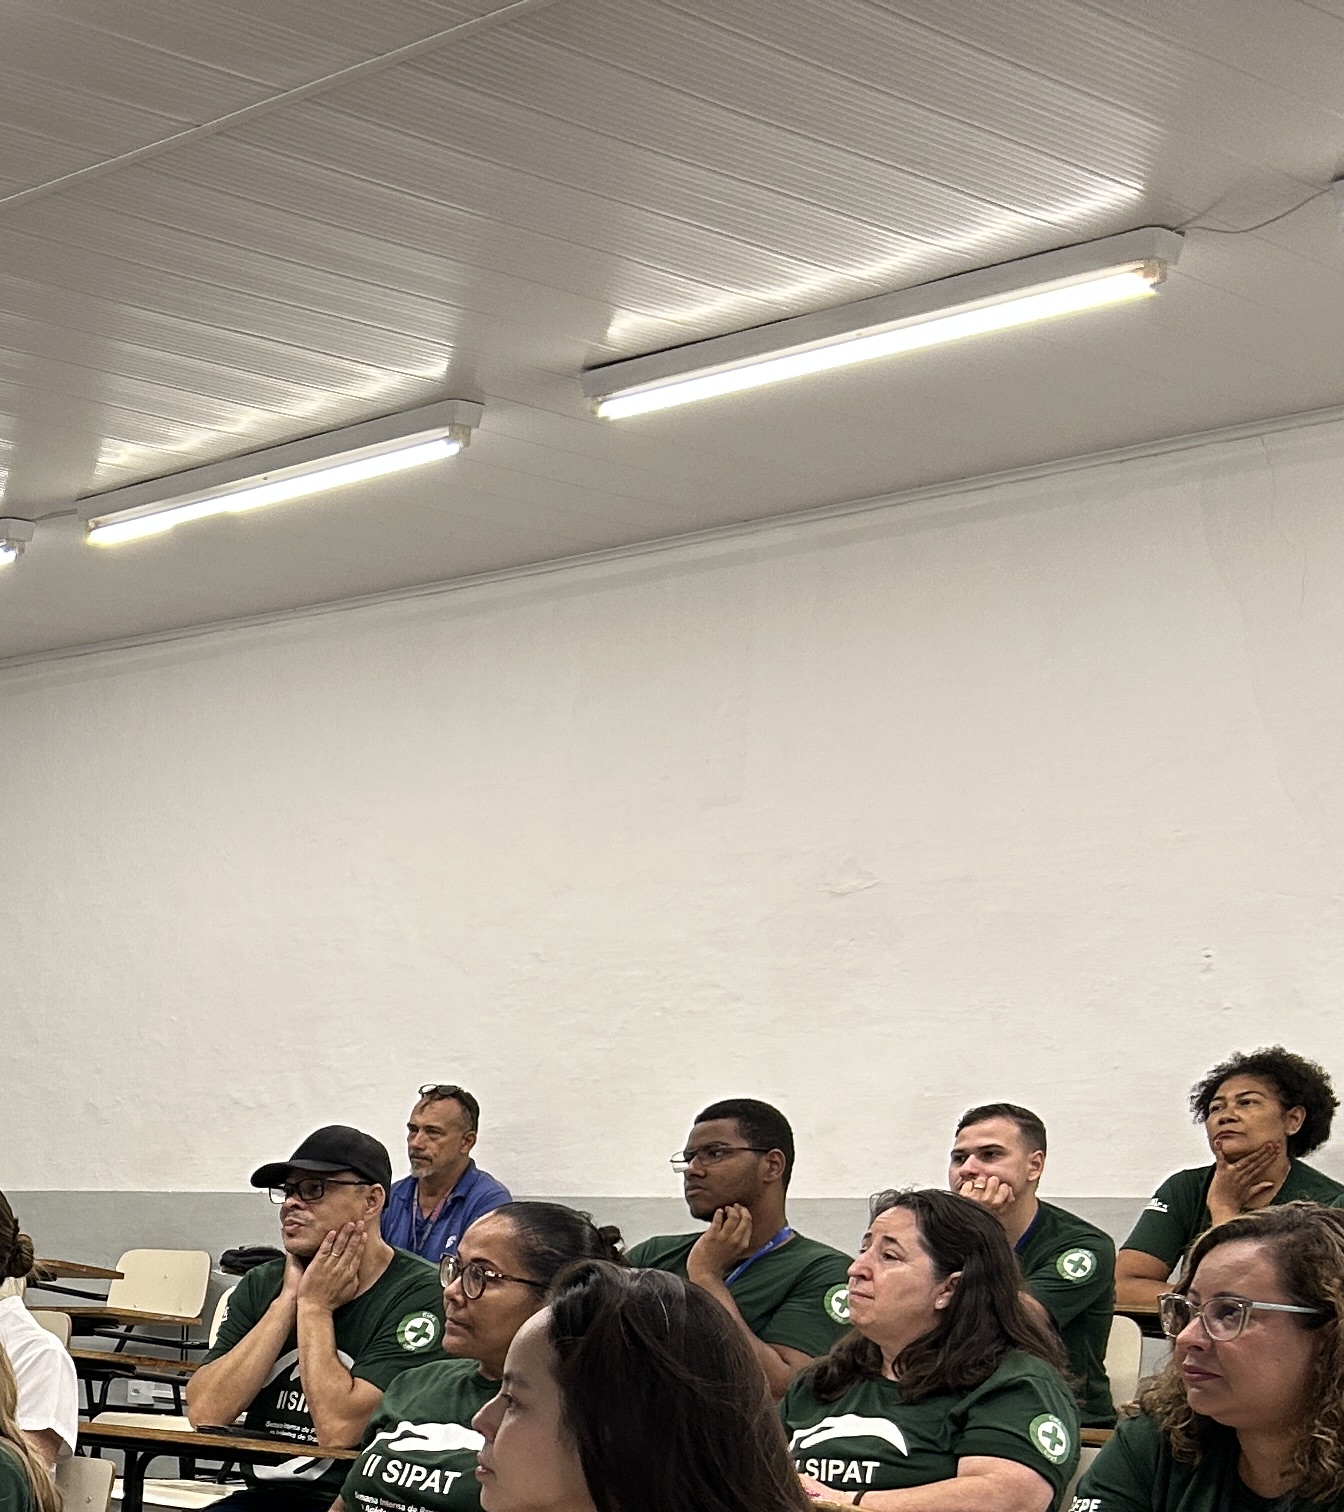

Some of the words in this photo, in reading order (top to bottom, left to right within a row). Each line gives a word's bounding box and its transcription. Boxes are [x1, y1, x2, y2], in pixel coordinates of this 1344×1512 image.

[362, 1454, 382, 1477] II
[382, 1459, 462, 1495] SIPAT
[805, 1458, 881, 1484] SIPAT
